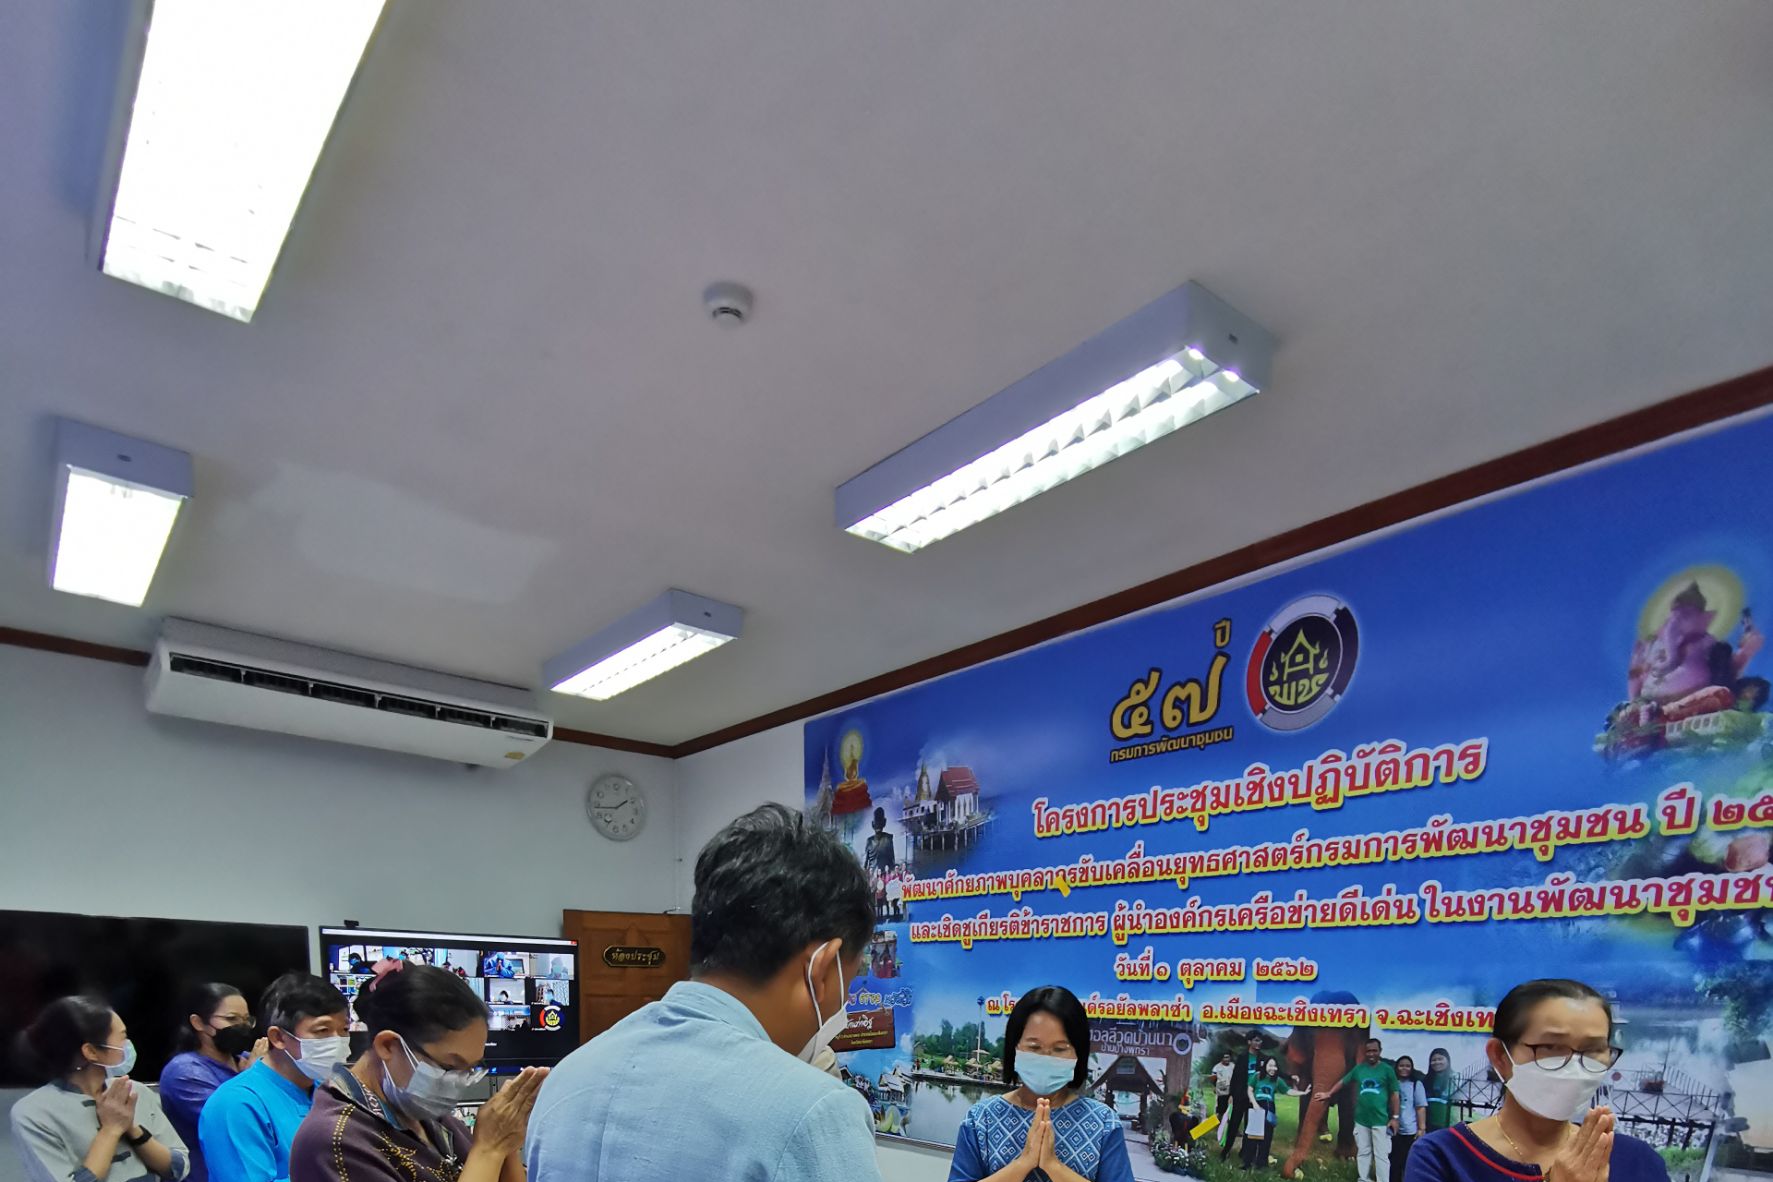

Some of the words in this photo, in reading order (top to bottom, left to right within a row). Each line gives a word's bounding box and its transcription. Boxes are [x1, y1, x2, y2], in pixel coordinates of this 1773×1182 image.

[1111, 727, 1233, 762] กรมการพัฒนาชุมชน
[1033, 742, 1485, 835] โครงการประชุมเชิงปฏิบัติการ
[1662, 787, 1695, 830] ปี
[911, 909, 1106, 946] และเชิดชูเกียรติข้าราชการ
[1180, 960, 1242, 985] ตุลาคม
[1255, 959, 1315, 977] ๒๕๖๒
[1376, 1002, 1495, 1028] จ.ฉะเชิงเท
